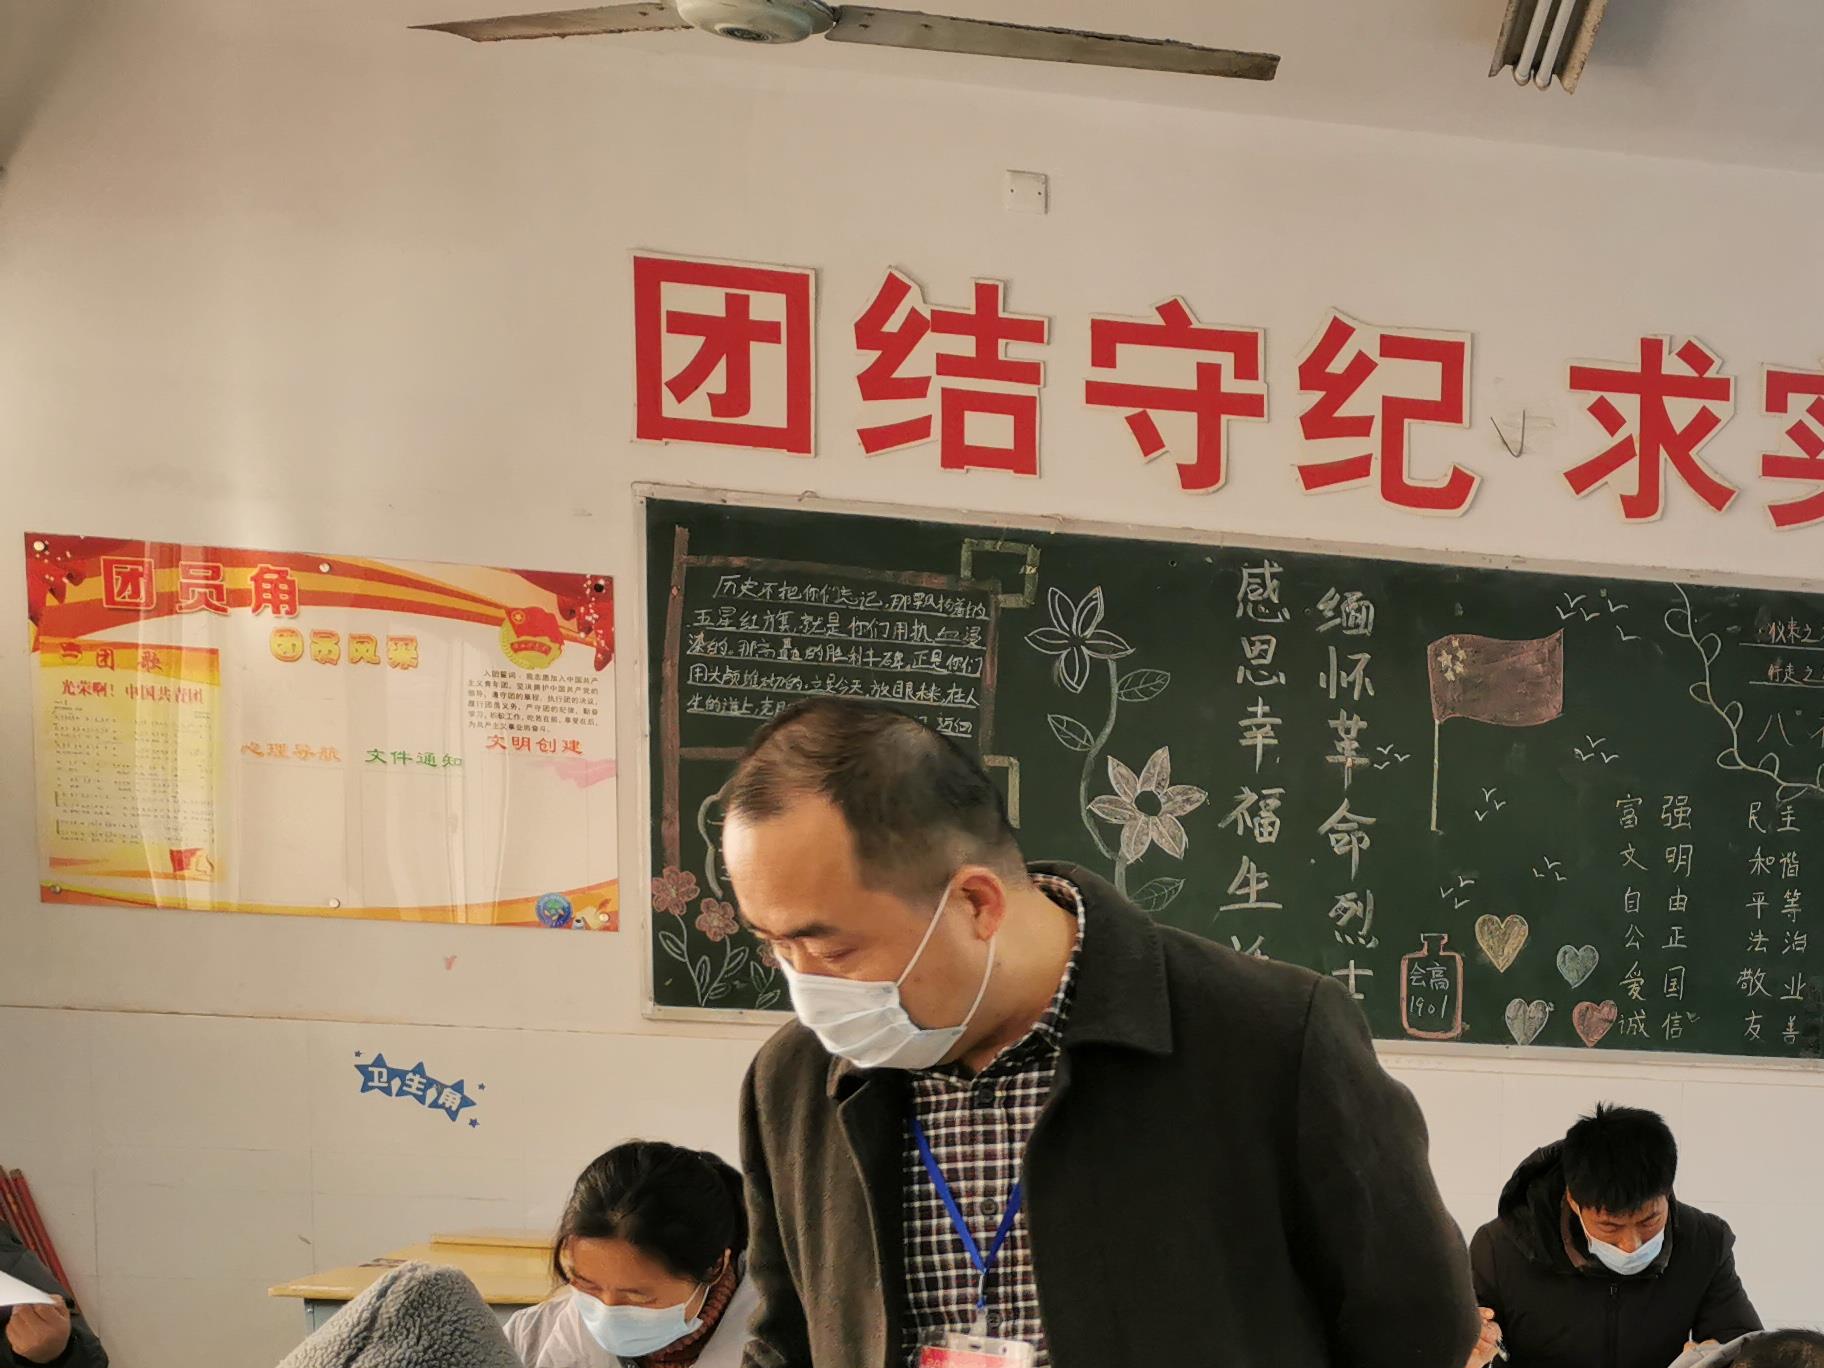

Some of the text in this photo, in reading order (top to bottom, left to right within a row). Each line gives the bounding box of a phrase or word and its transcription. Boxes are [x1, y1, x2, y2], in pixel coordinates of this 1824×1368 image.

[633, 257, 1480, 513] 团结守纪
[98, 556, 302, 619] 团员角
[240, 740, 342, 764] 心理导航
[364, 748, 464, 768] 文件通知
[486, 734, 584, 755] 文明创建
[1315, 587, 1378, 1000] 缅怀革命烈士
[368, 1066, 463, 1112] 卫生角
